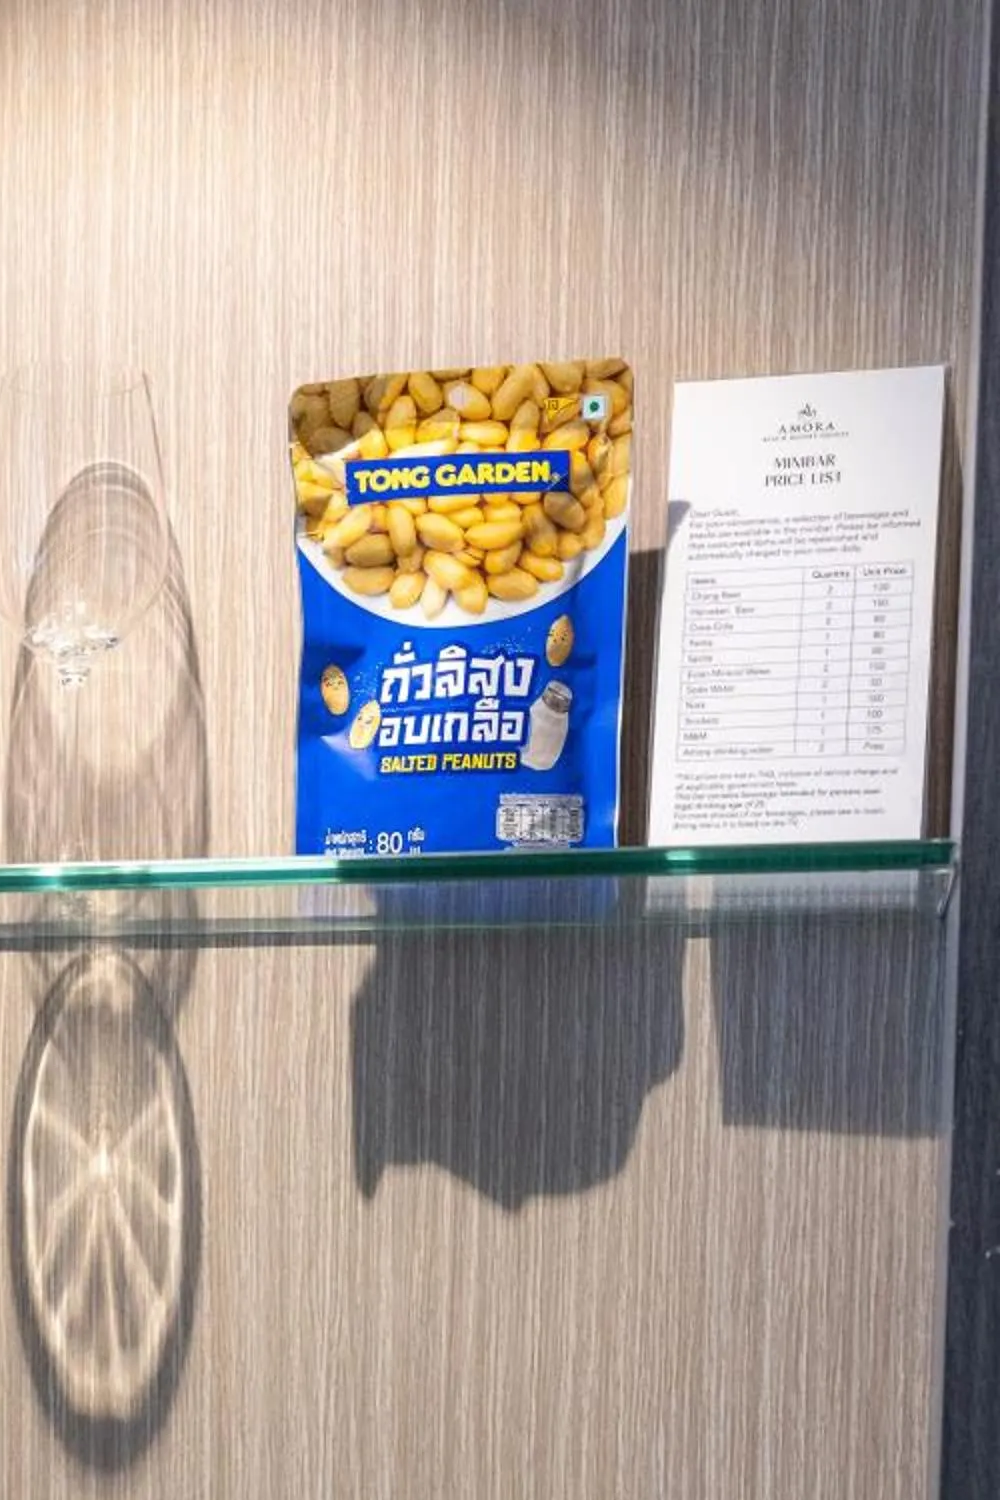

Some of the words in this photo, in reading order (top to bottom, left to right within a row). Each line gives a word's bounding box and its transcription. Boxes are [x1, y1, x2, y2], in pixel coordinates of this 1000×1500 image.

[778, 421, 835, 434] AMORA
[774, 454, 836, 469] MINIBAR
[353, 465, 431, 494] TONG
[435, 460, 551, 488] GARDEN
[765, 473, 803, 487] PRICE
[811, 471, 841, 485] LIST
[379, 640, 535, 704] ถั่วลิสง
[378, 697, 525, 747] อบเกลือ
[379, 754, 437, 774] SALTED
[441, 752, 518, 772] PEANUTS
[377, 831, 404, 855] 80
